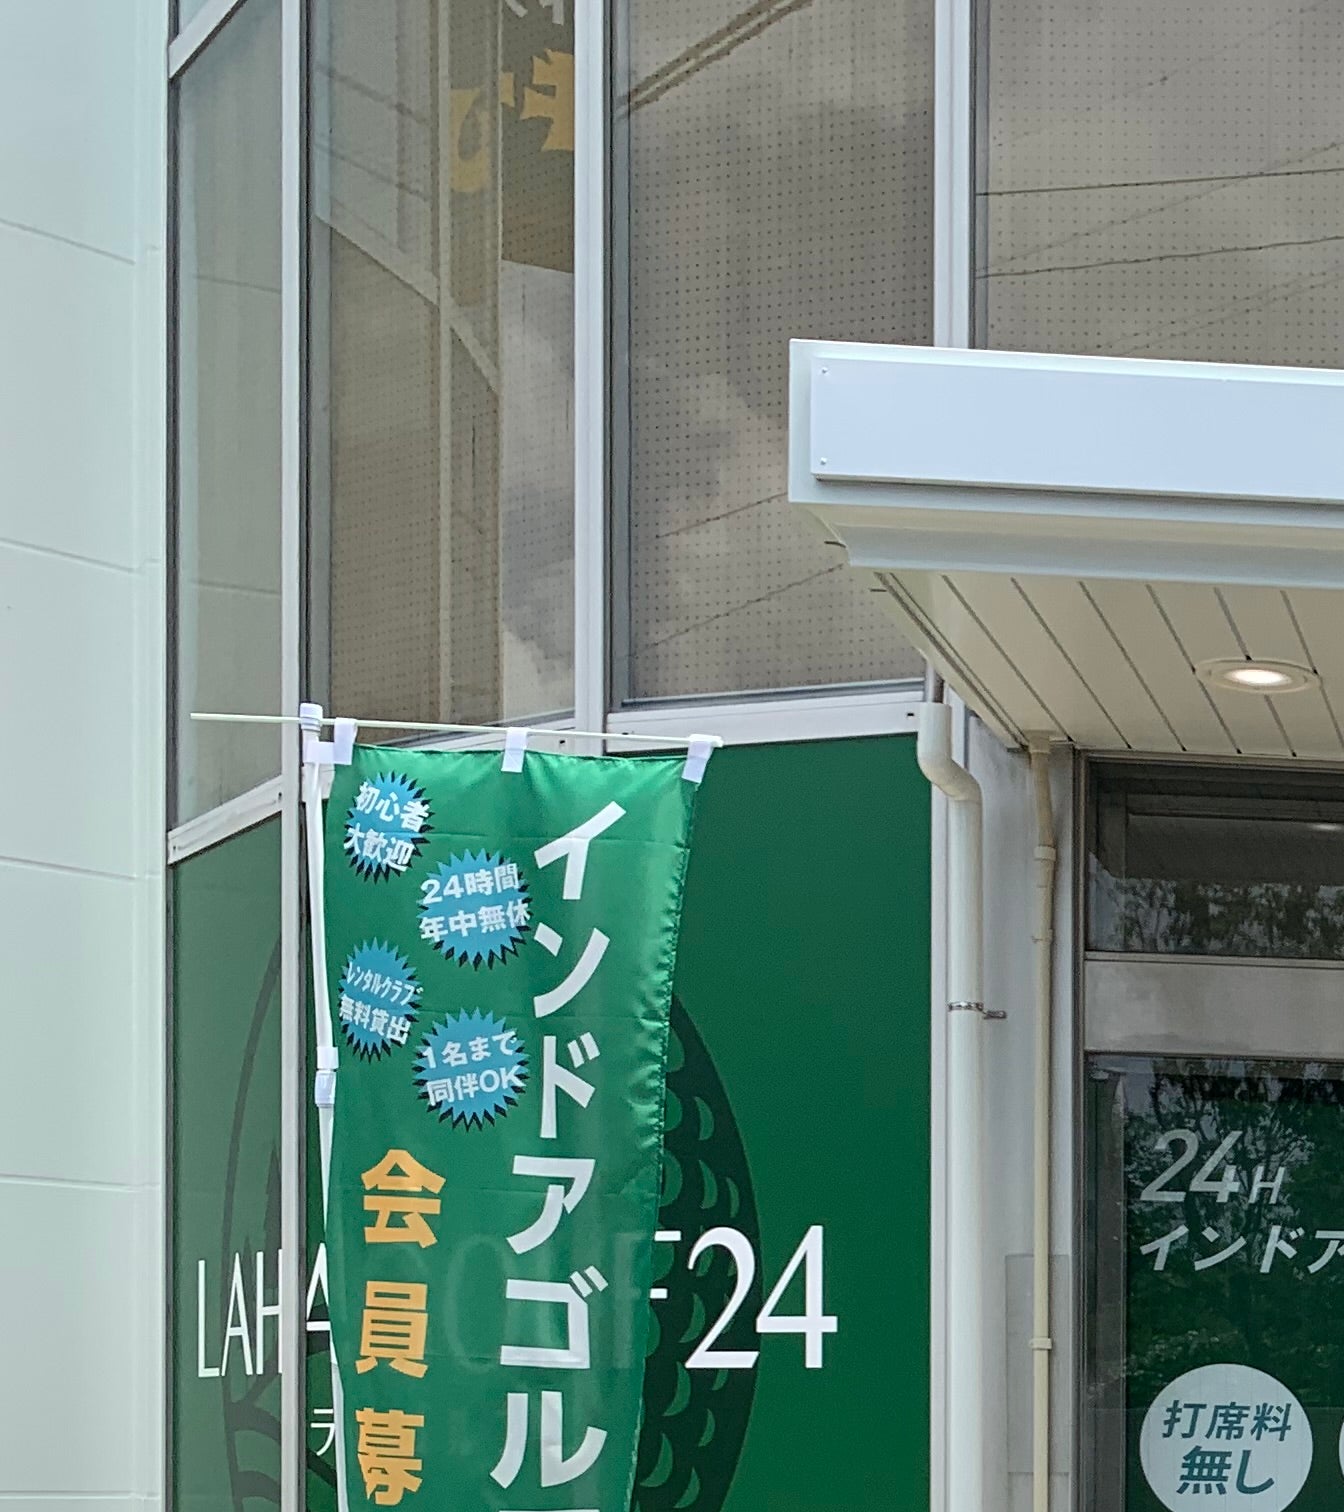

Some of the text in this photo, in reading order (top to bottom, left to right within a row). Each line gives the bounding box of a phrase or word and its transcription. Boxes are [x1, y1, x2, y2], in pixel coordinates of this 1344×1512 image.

[355, 781, 430, 832] 初心者
[343, 823, 415, 872] 大歓迎
[421, 863, 521, 904] 24時間
[419, 899, 531, 942] 年中無休
[346, 962, 423, 1005] レンタルクラブ
[339, 994, 412, 1044] 無料貸出
[422, 1031, 517, 1068] 1名まで
[426, 1066, 525, 1106] 同伴OK
[1140, 1129, 1285, 1205] 24H
[198, 1225, 838, 1378] LAHA24
[1162, 1399, 1292, 1442] 打席料
[1177, 1445, 1276, 1496] 無し
